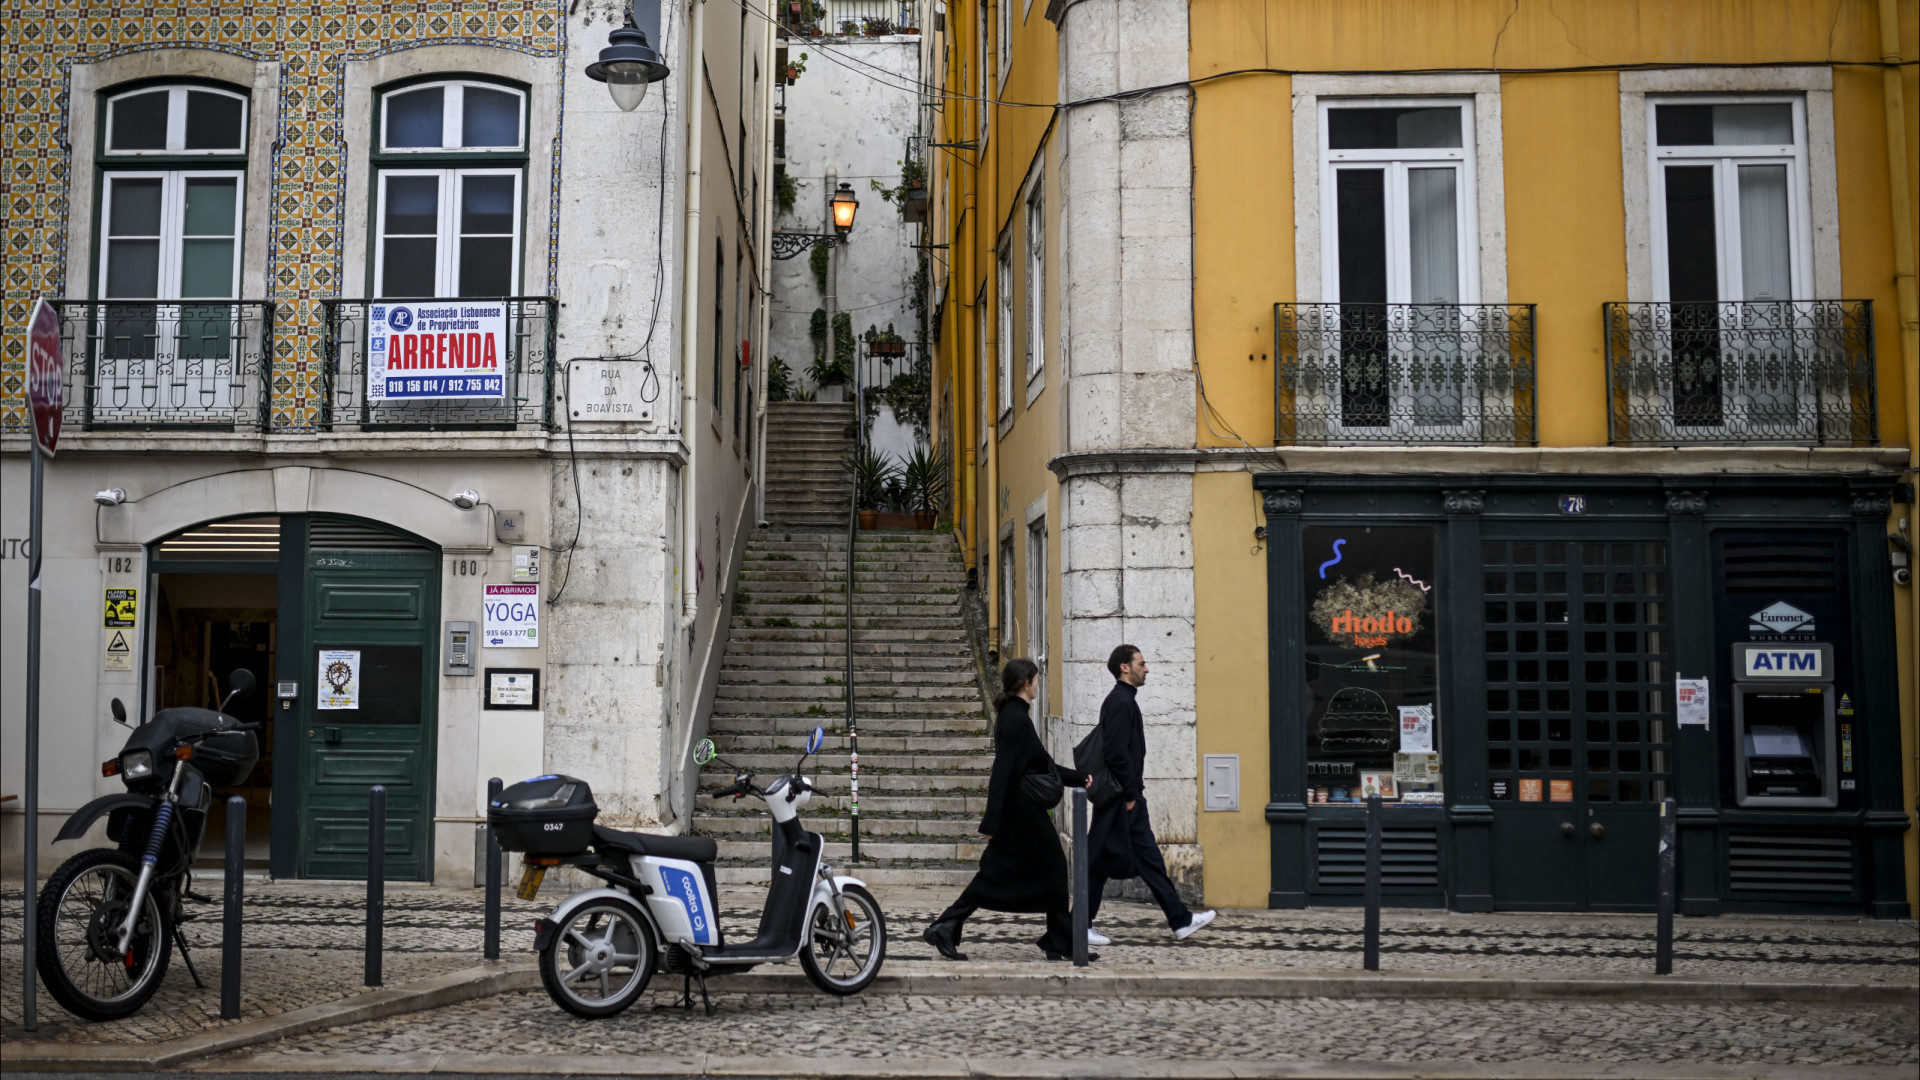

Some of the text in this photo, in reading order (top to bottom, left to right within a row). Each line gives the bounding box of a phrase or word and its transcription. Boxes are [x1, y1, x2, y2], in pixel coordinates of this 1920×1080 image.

[417, 307, 501, 319] Associação Lisbonense
[417, 318, 479, 332] de Proprietários
[387, 332, 498, 370] ARRENDA
[31, 342, 62, 410] STOP
[601, 369, 621, 379] RUA
[388, 379, 500, 393] 918 156 014 / 912 755 842
[604, 386, 617, 396] DA
[586, 403, 634, 413] BOAVISTA
[1568, 496, 1584, 513] 78
[503, 519, 516, 528] AL
[107, 557, 132, 573] 182
[453, 560, 477, 576] 180
[489, 585, 536, 594] JÁ ABRIMOS
[484, 602, 537, 622] YOGA
[1760, 611, 1805, 623] Euronet
[1331, 610, 1413, 633] rhodo
[1752, 652, 1816, 671] ATM
[543, 823, 564, 831] 0347
[682, 876, 698, 914] cooltra
